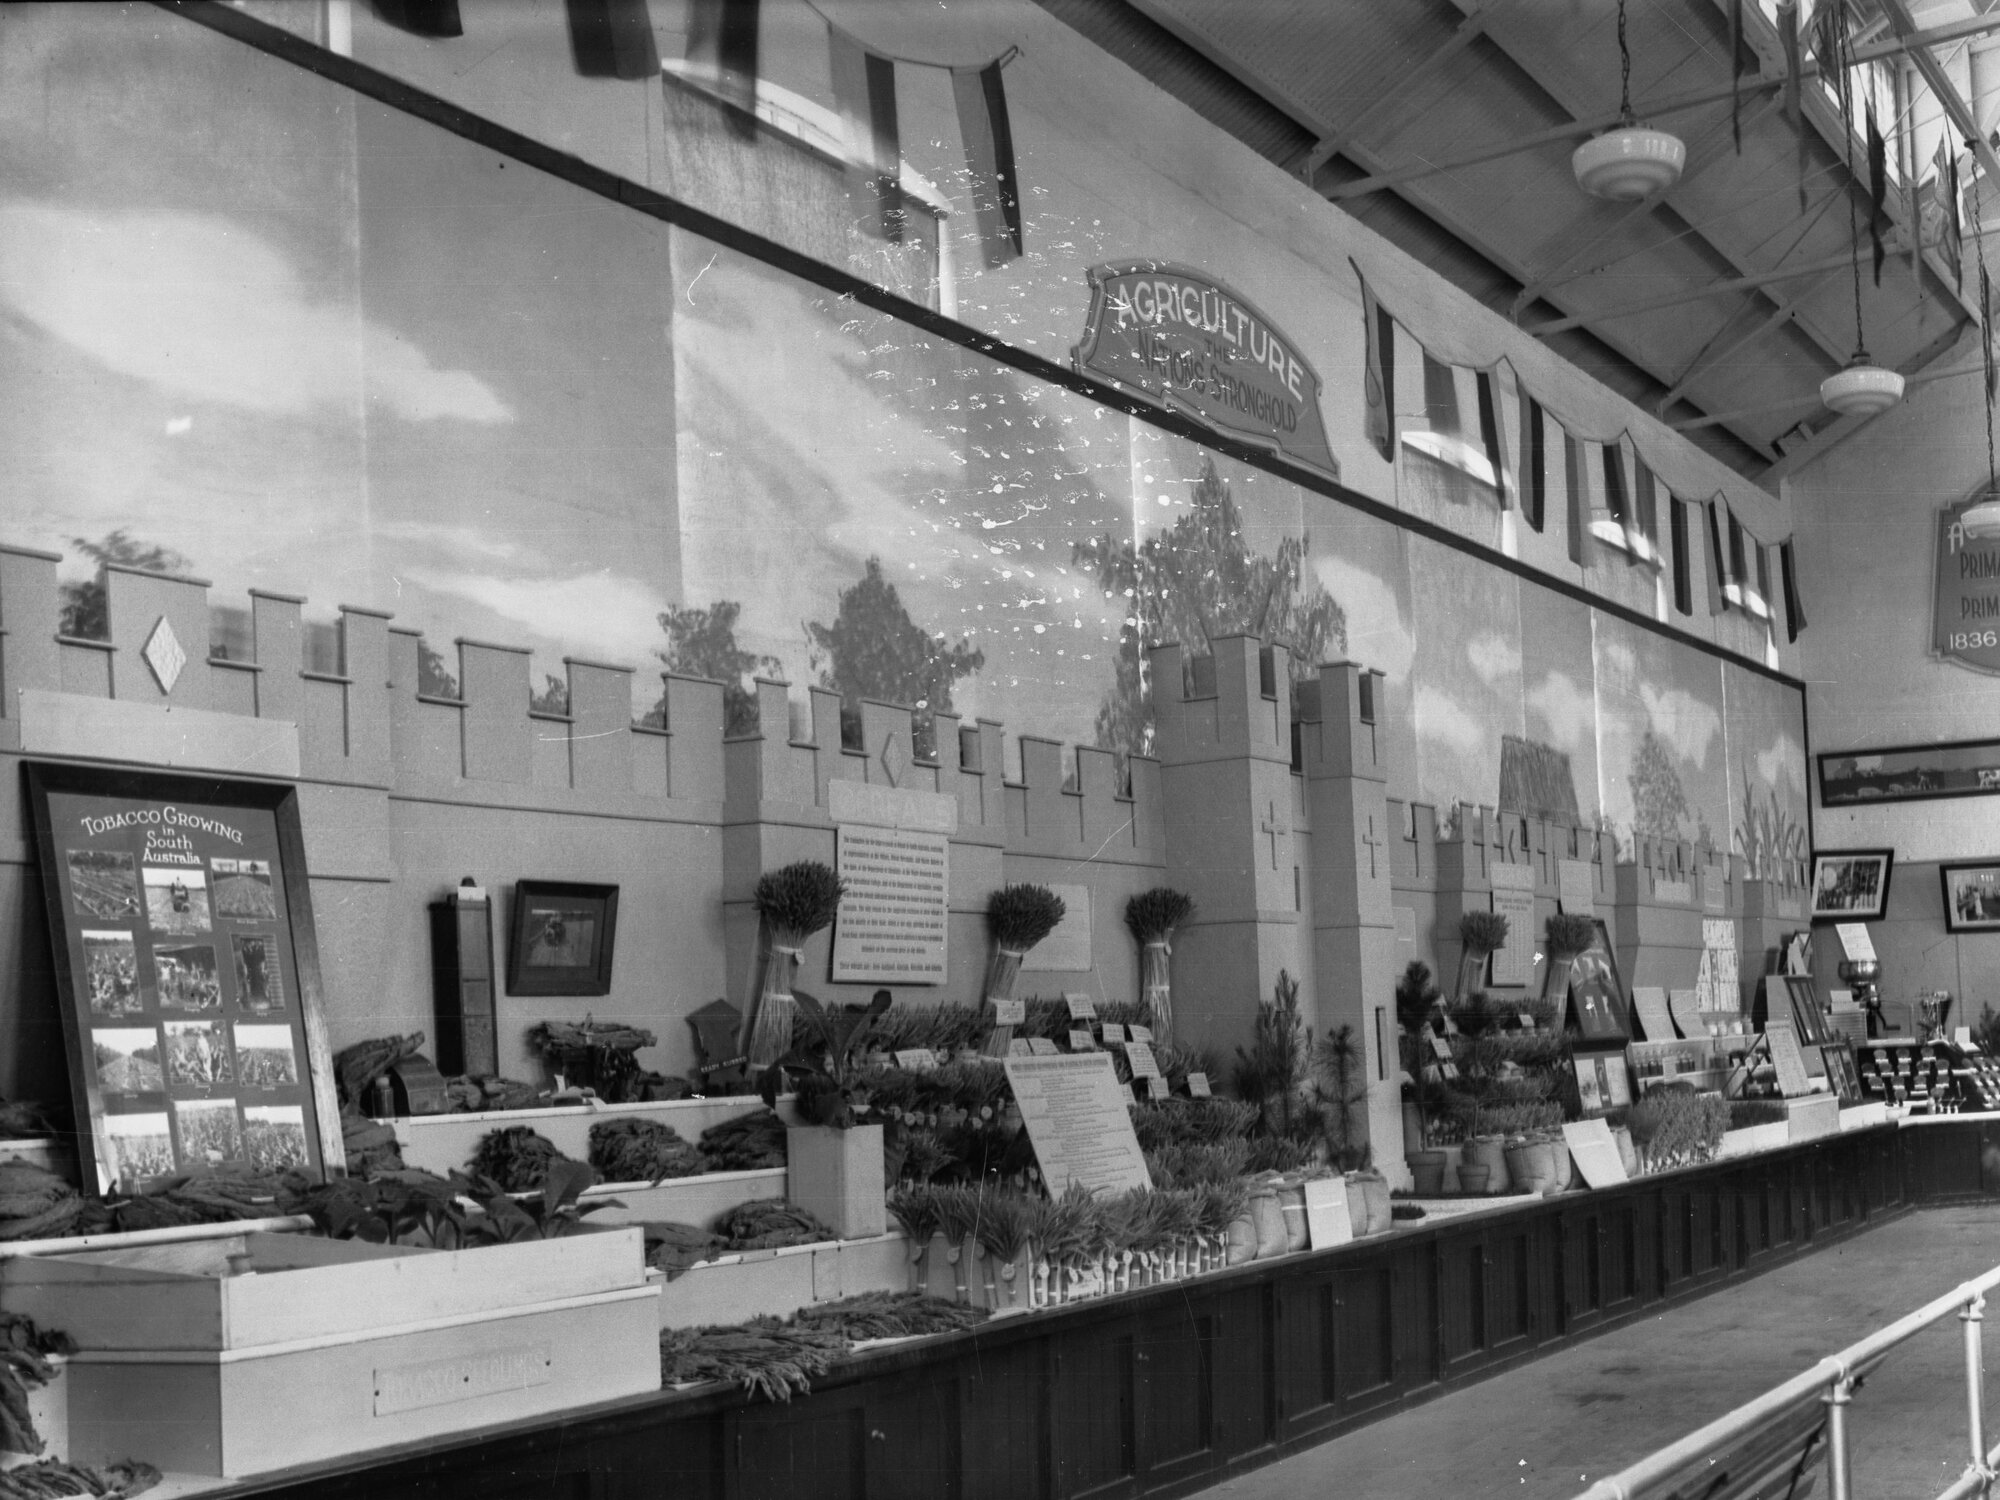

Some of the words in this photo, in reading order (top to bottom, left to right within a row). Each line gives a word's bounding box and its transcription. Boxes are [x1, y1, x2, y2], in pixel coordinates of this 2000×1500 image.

[1117, 281, 1303, 402] AGRICULTURE
[1204, 339, 1234, 366] THE
[1210, 364, 1297, 433] STRONGHOLD
[1949, 630, 1998, 650] 1836
[81, 810, 161, 836] TOBACCO
[162, 825, 175, 836] in
[146, 830, 193, 850] South
